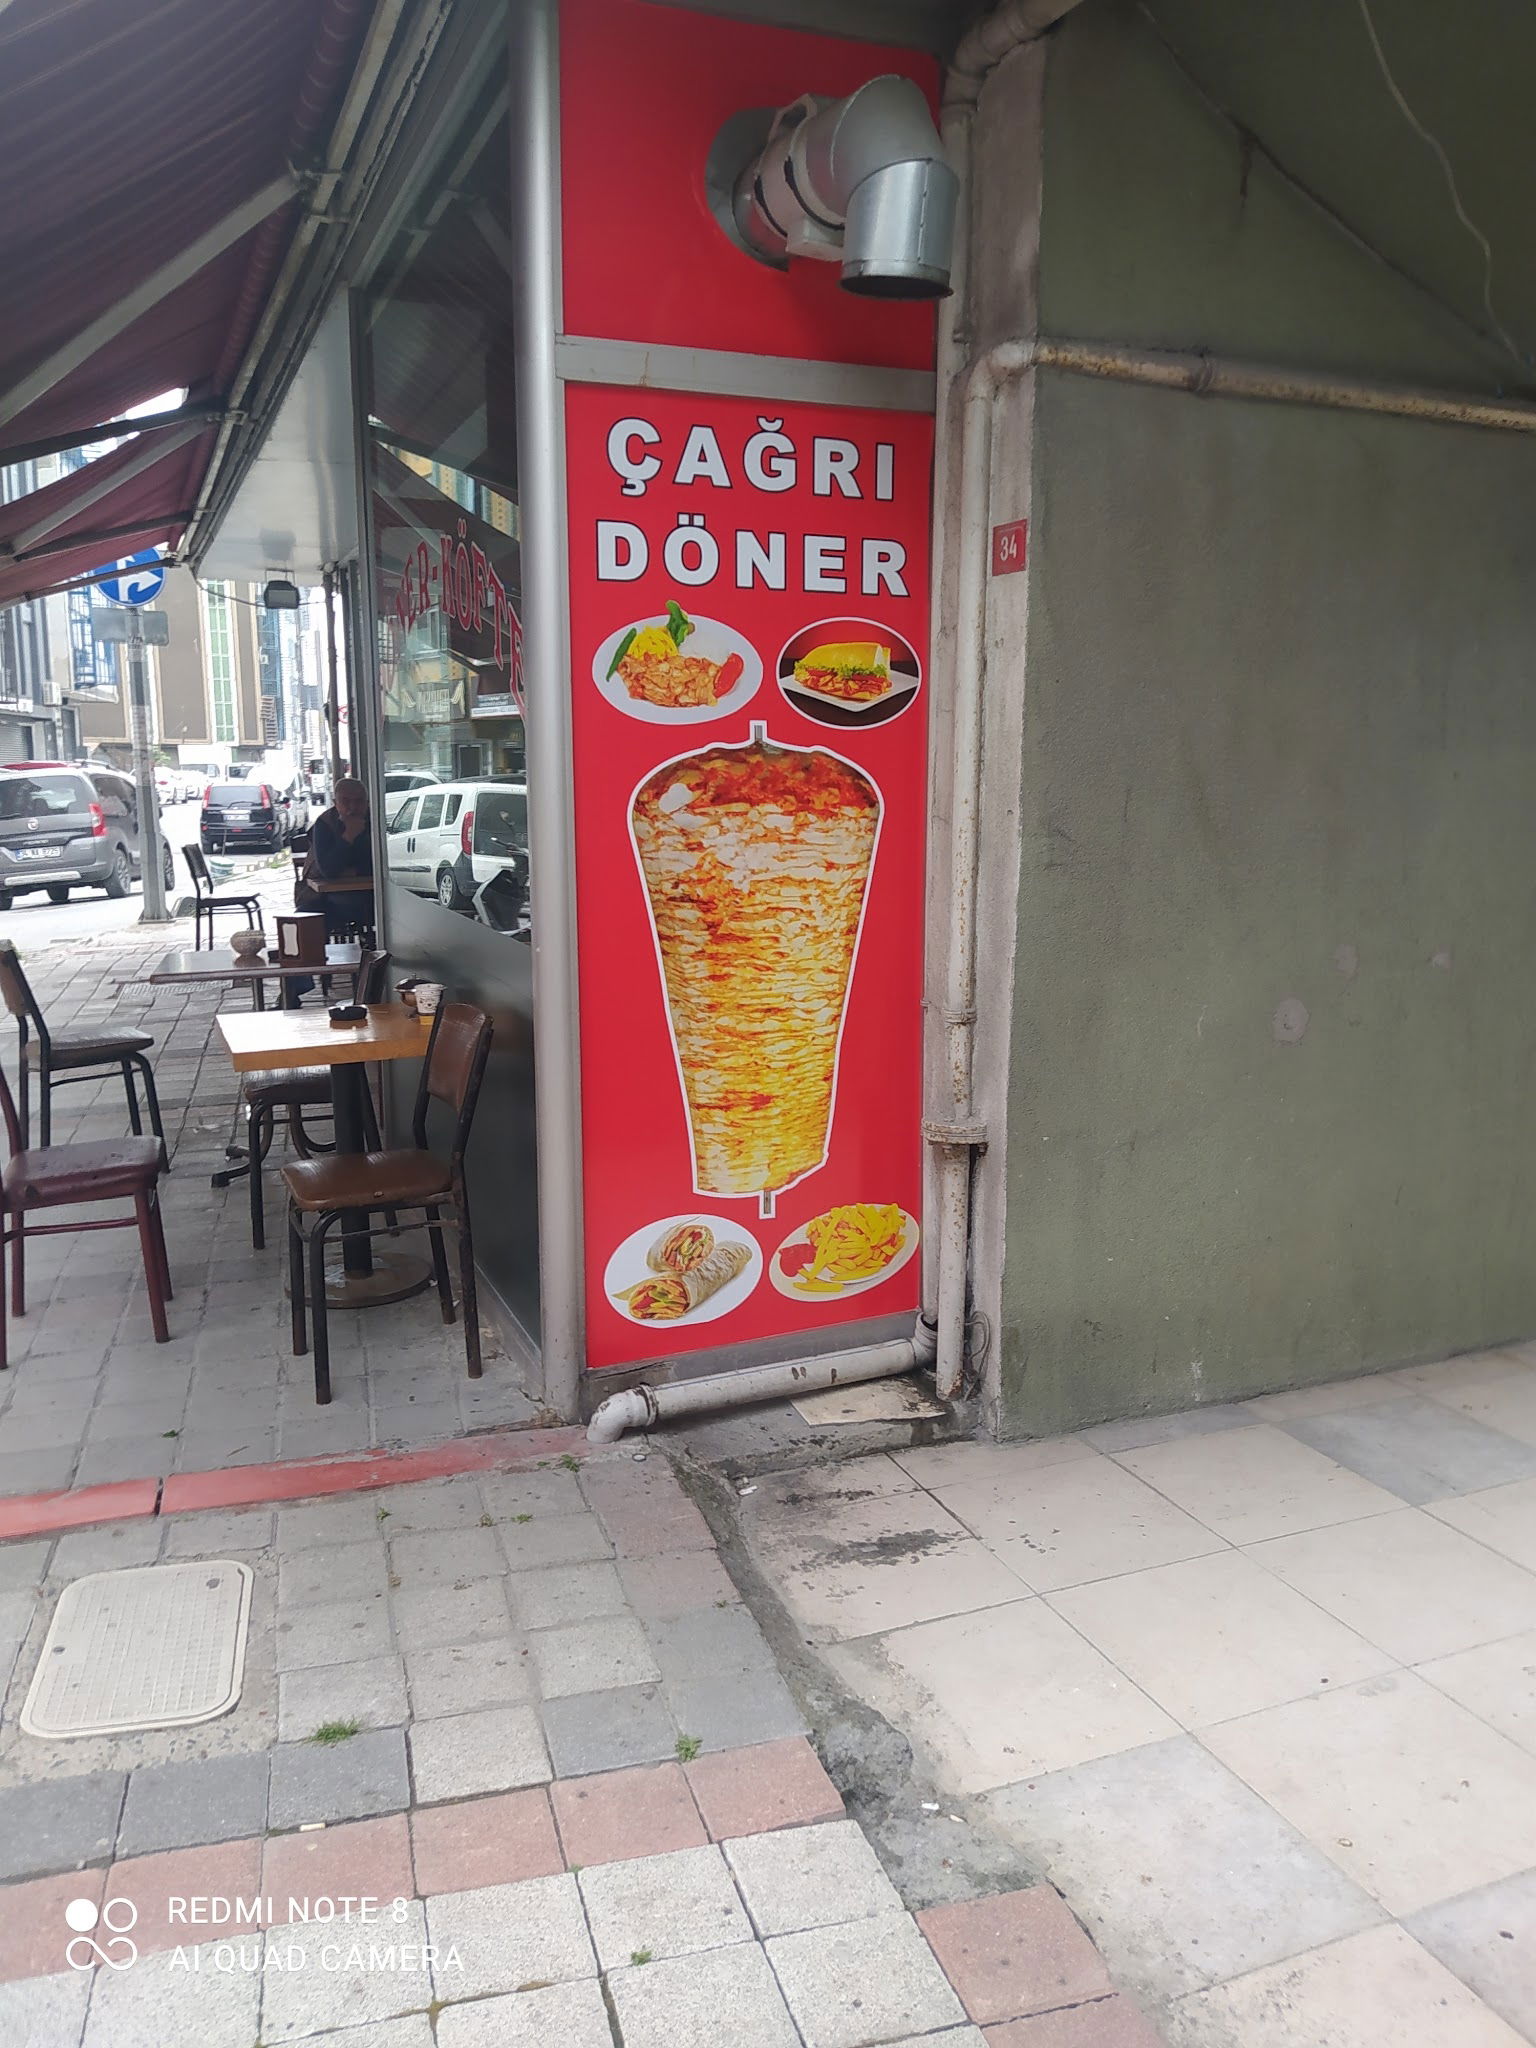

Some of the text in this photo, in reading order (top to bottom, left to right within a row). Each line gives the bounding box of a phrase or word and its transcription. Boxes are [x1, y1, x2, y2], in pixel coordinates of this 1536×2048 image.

[606, 416, 895, 501] ÇAĞRI
[595, 512, 911, 598] DÖNER
[1000, 534, 1017, 561] 34
